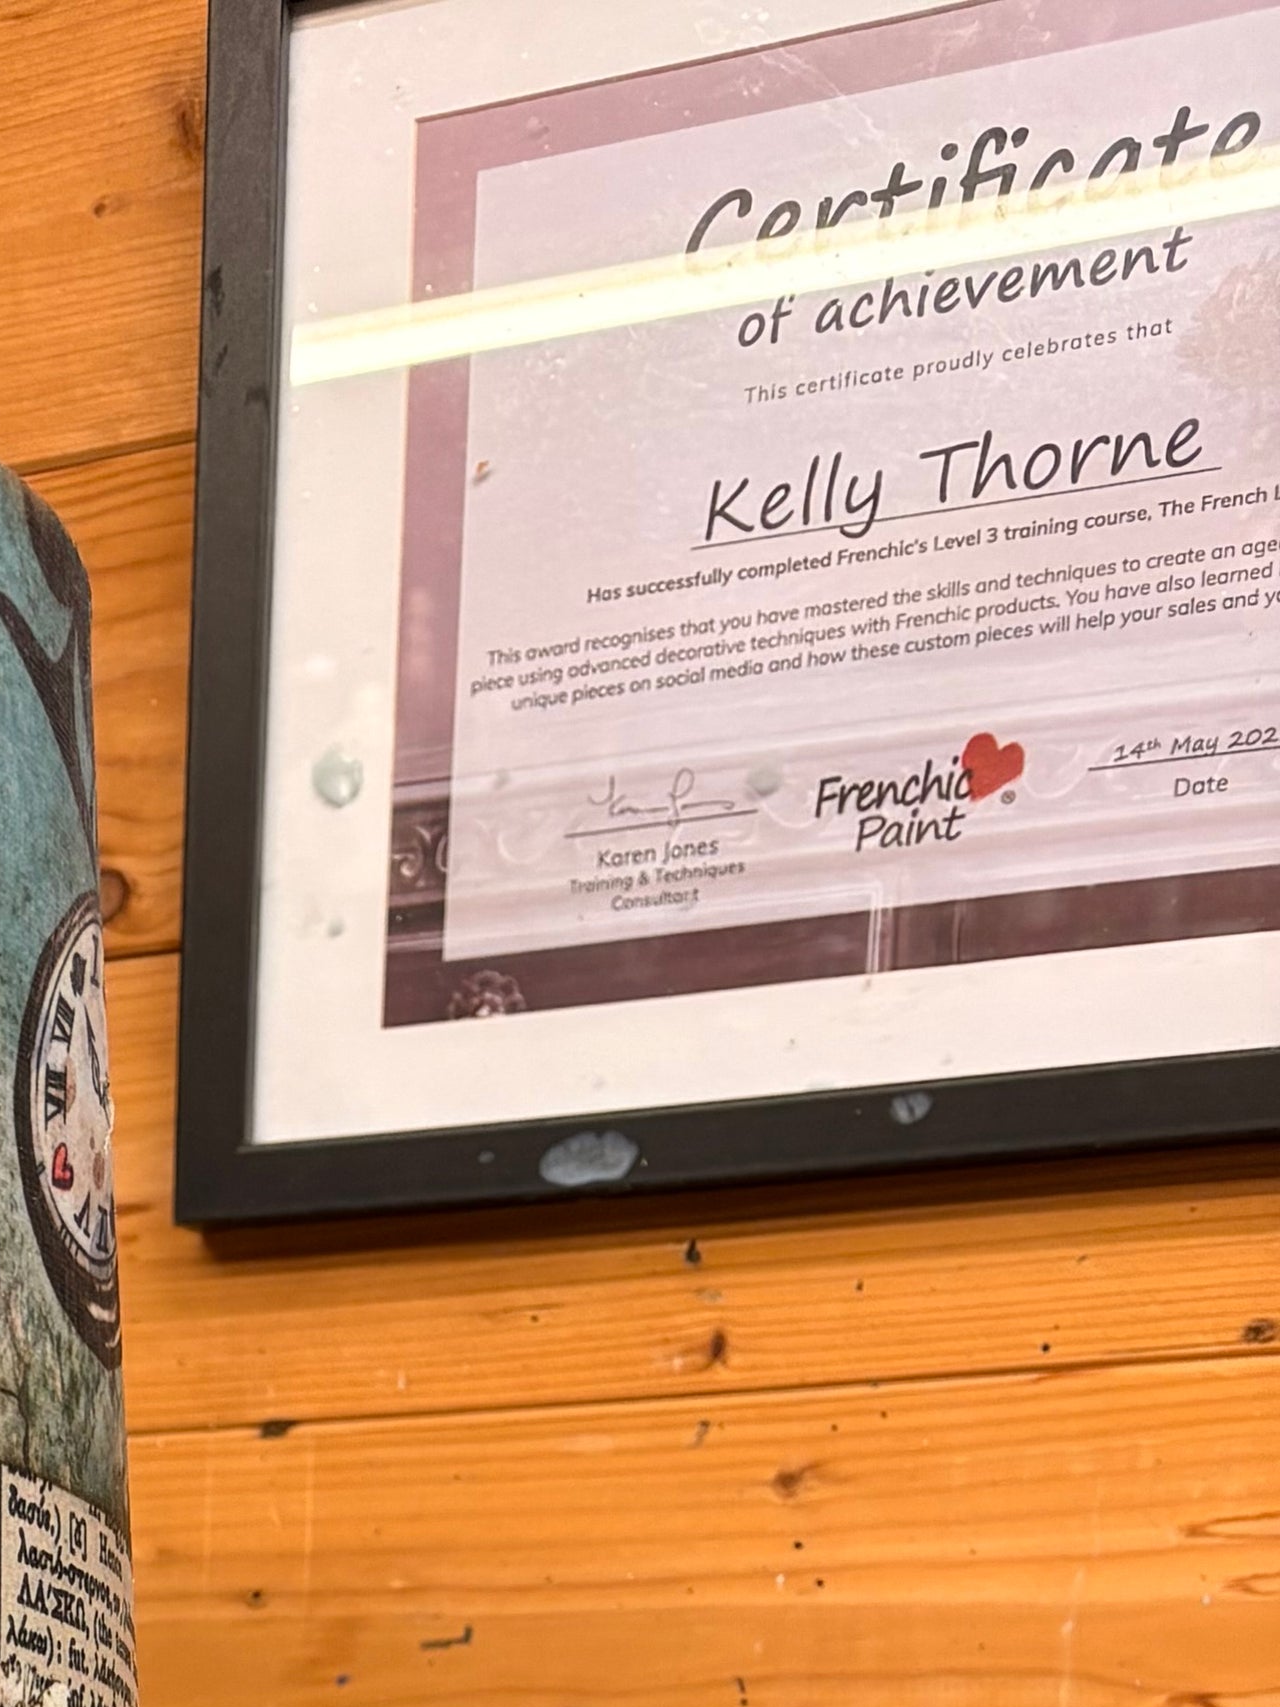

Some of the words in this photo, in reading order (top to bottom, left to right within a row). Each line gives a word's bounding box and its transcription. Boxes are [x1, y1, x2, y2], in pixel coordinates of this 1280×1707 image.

[739, 293, 794, 348] of
[814, 224, 1194, 336] achievement
[745, 382, 787, 405] This
[794, 363, 904, 396] certificate
[913, 347, 995, 383] proudly
[1002, 328, 1116, 363] celebrates
[1127, 317, 1174, 341] that
[704, 450, 883, 539] Kelly
[920, 417, 1203, 503] Thorne
[587, 587, 621, 604] Has
[626, 565, 733, 600] successfully
[737, 551, 832, 582] completed
[836, 538, 928, 567] Frenchic's
[933, 526, 982, 552] Level
[987, 528, 998, 543] 3
[1003, 517, 1078, 542] training
[1084, 506, 1152, 529] course,
[1158, 499, 1195, 519] The
[1201, 486, 1269, 513] French
[470, 675, 514, 698] piece
[519, 664, 563, 689] using
[568, 651, 651, 679] advanced
[656, 639, 746, 667] decorative
[750, 625, 846, 654] techniques
[851, 617, 890, 641] with
[895, 606, 970, 632] Frenchic
[975, 593, 1060, 621] products.
[1066, 587, 1099, 608] You
[1105, 583, 1151, 602] have
[1156, 574, 1196, 595] also
[1201, 562, 1273, 589] learned
[488, 649, 522, 667] This
[525, 637, 580, 659] award
[584, 626, 675, 655] recognises
[680, 618, 716, 637] that
[720, 613, 752, 635] you
[757, 604, 799, 624] have
[804, 592, 887, 620] mastered
[893, 588, 922, 608] the
[926, 577, 970, 601] skills
[975, 572, 1011, 594] and
[1016, 560, 1117, 590] techniques
[1122, 557, 1141, 573] to
[1146, 548, 1206, 570] create
[1212, 545, 1236, 562] an
[511, 690, 568, 713] unique
[571, 682, 625, 706] pieces
[629, 676, 651, 692] on
[656, 667, 705, 691] social
[710, 658, 763, 683] media
[768, 655, 802, 674] and
[807, 647, 846, 669] how
[851, 641, 900, 662] these
[904, 633, 971, 655] custom
[975, 623, 1033, 648] pieces
[1040, 612, 1070, 634] will
[1075, 608, 1116, 631] help
[1120, 604, 1161, 629] your
[1167, 596, 1217, 618] sales
[1221, 589, 1259, 611] and
[814, 756, 974, 819] Frenchic
[1170, 734, 1219, 758] May
[1227, 726, 1280, 749] 202
[1173, 775, 1229, 799] Date
[596, 846, 657, 869] Karen
[663, 838, 719, 862] Jones
[855, 804, 967, 853] Paint
